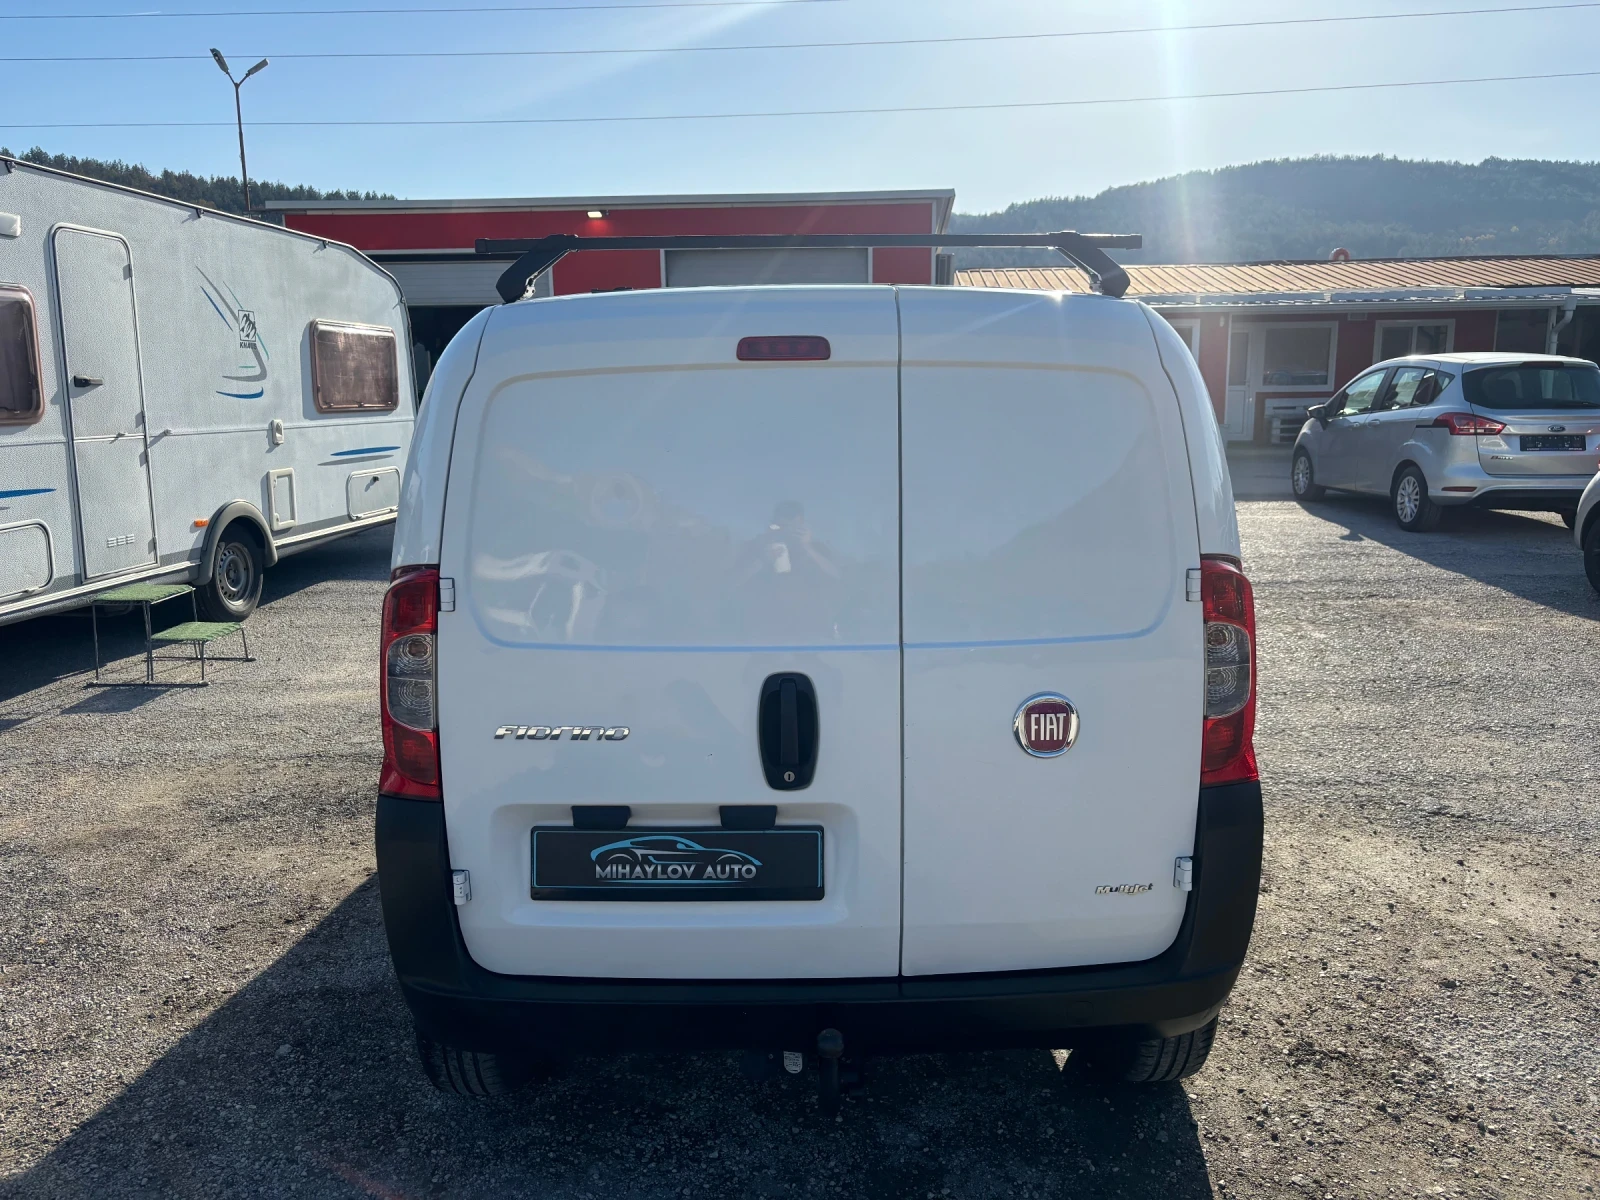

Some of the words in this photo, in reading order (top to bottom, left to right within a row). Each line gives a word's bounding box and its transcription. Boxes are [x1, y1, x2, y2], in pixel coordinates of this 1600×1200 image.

[494, 724, 630, 741] Fiorino
[1030, 712, 1067, 741] FIAT
[595, 863, 696, 879] MIHAYLOV
[702, 863, 757, 879] AUTO
